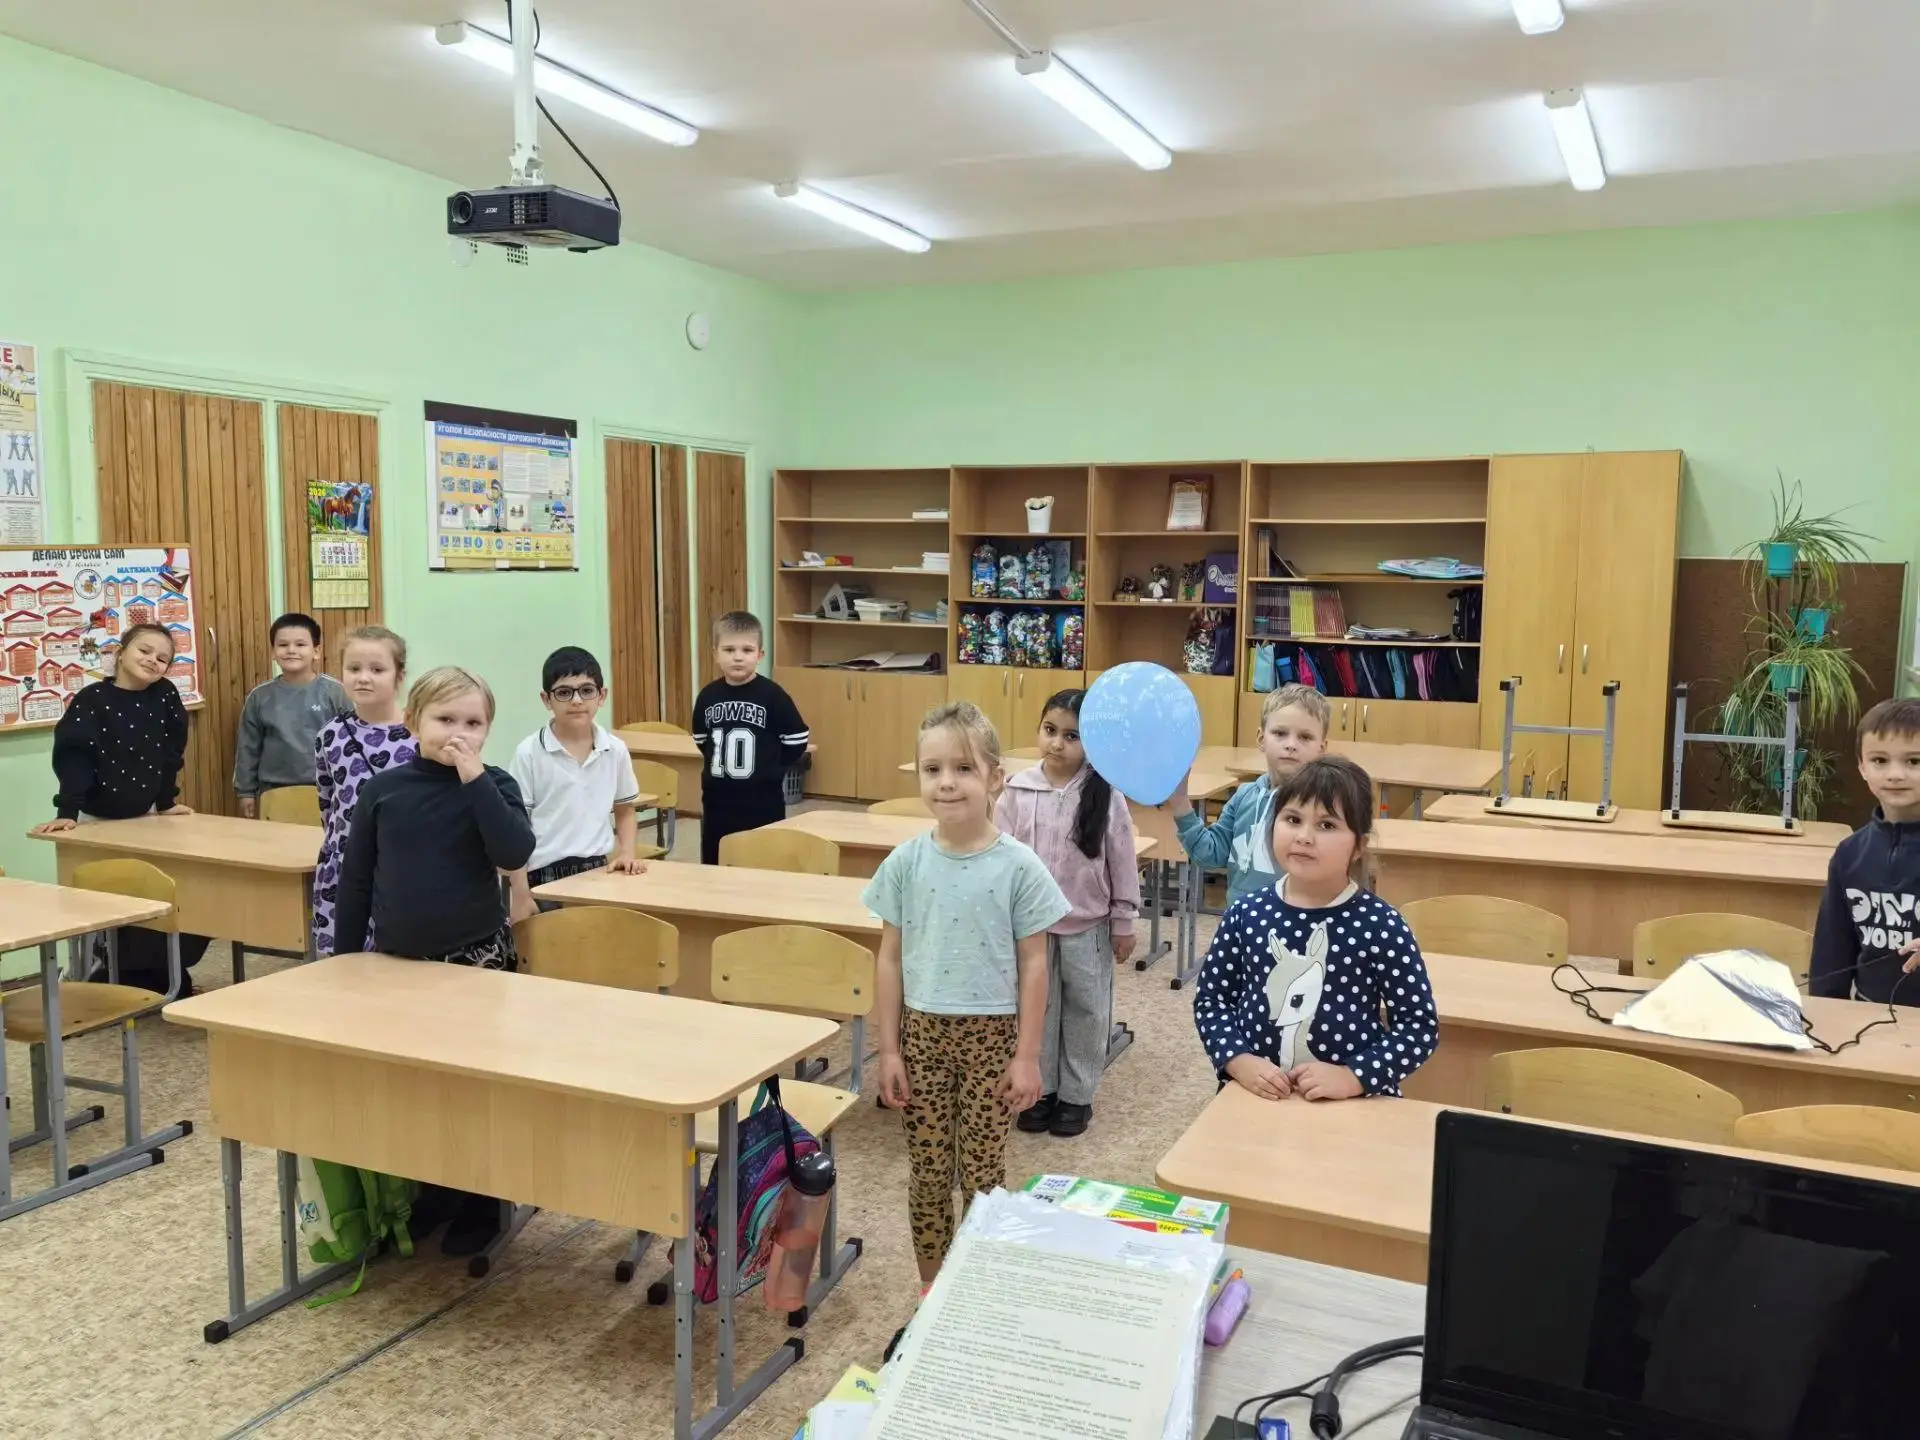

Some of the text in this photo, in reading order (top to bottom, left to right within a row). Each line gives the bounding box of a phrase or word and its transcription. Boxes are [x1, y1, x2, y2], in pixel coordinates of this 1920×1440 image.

[0, 347, 13, 363] Е
[438, 424, 462, 434] УГОЛОК
[464, 426, 507, 441] БЕЗОПАСНОСТИ
[507, 433, 541, 446] ДОРОЖНОГО
[32, 548, 125, 562] ДЕЛАЮ УРОКИ САМ
[704, 700, 767, 729] POWER
[710, 727, 755, 780] 10
[1845, 887, 1920, 927] DIN
